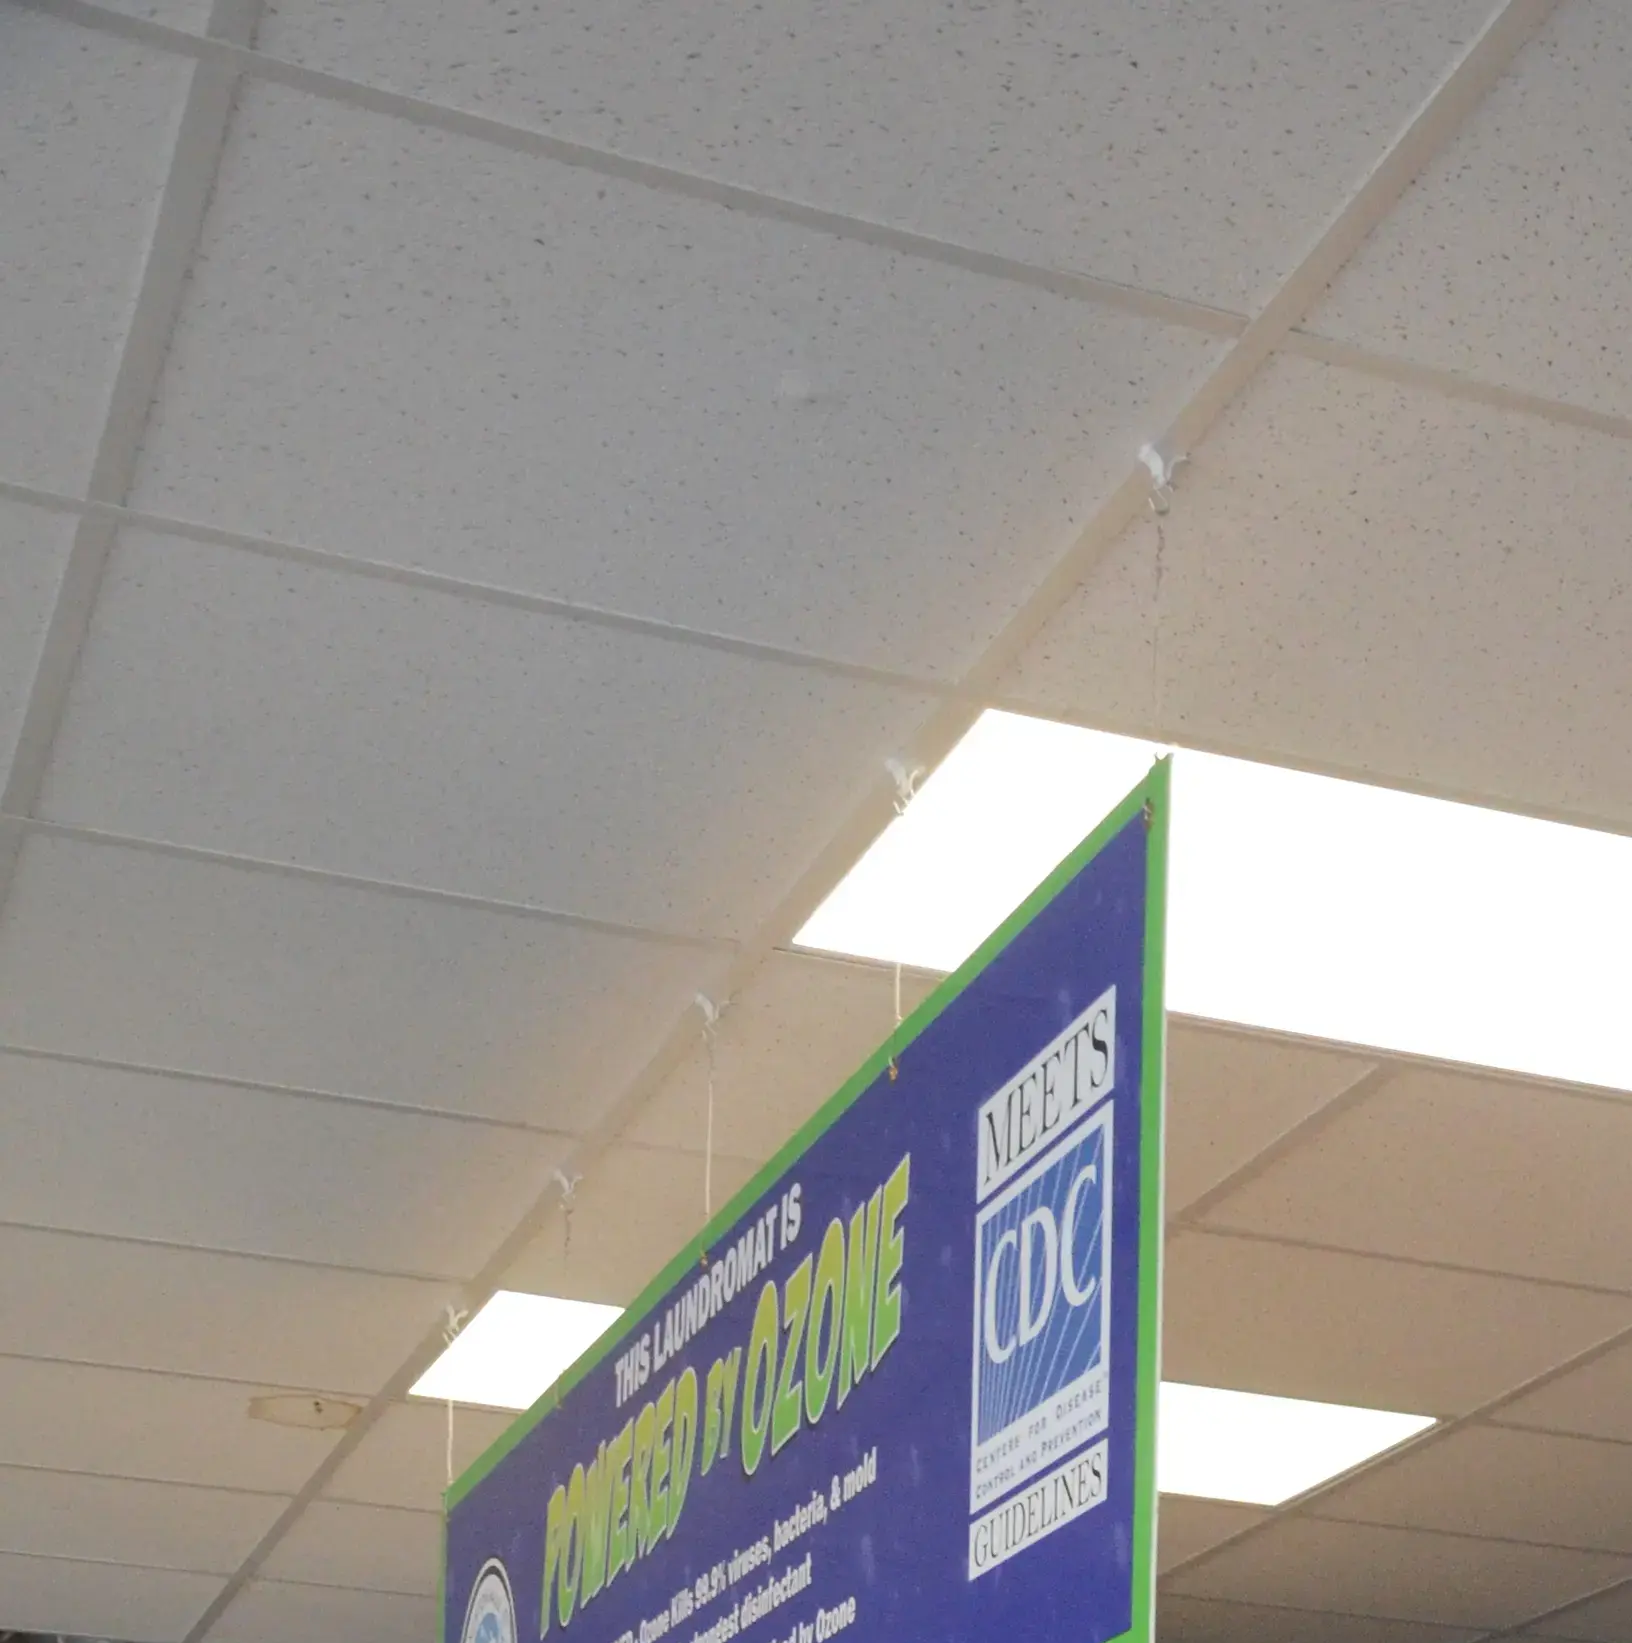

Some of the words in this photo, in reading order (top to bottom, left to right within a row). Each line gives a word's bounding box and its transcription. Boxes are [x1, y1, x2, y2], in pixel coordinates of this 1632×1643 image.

[984, 1009, 1108, 1186] MEETS
[615, 1334, 650, 1408] THIS
[653, 1204, 778, 1373] LAUNDROMAT
[780, 1183, 801, 1250] IS
[983, 1164, 1098, 1364] CDC
[540, 1366, 698, 1640] POWERED
[701, 1347, 742, 1476] BY
[741, 1152, 910, 1475] OZONE
[975, 1468, 1015, 1500] CONTROL
[1019, 1451, 1037, 1470] AND
[1041, 1408, 1101, 1457] PREVENTION
[1028, 1417, 1046, 1438] FOR
[1056, 1380, 1101, 1420] DISEASE
[695, 1560, 726, 1610] 99.9%
[728, 1535, 772, 1585] viruses,
[774, 1490, 828, 1553] bacteria,
[829, 1475, 841, 1510] &
[843, 1446, 877, 1502] mold
[974, 1453, 1102, 1567] GUIDELINES
[740, 1552, 812, 1630] disinfectant
[815, 1596, 856, 1643] Ozone
